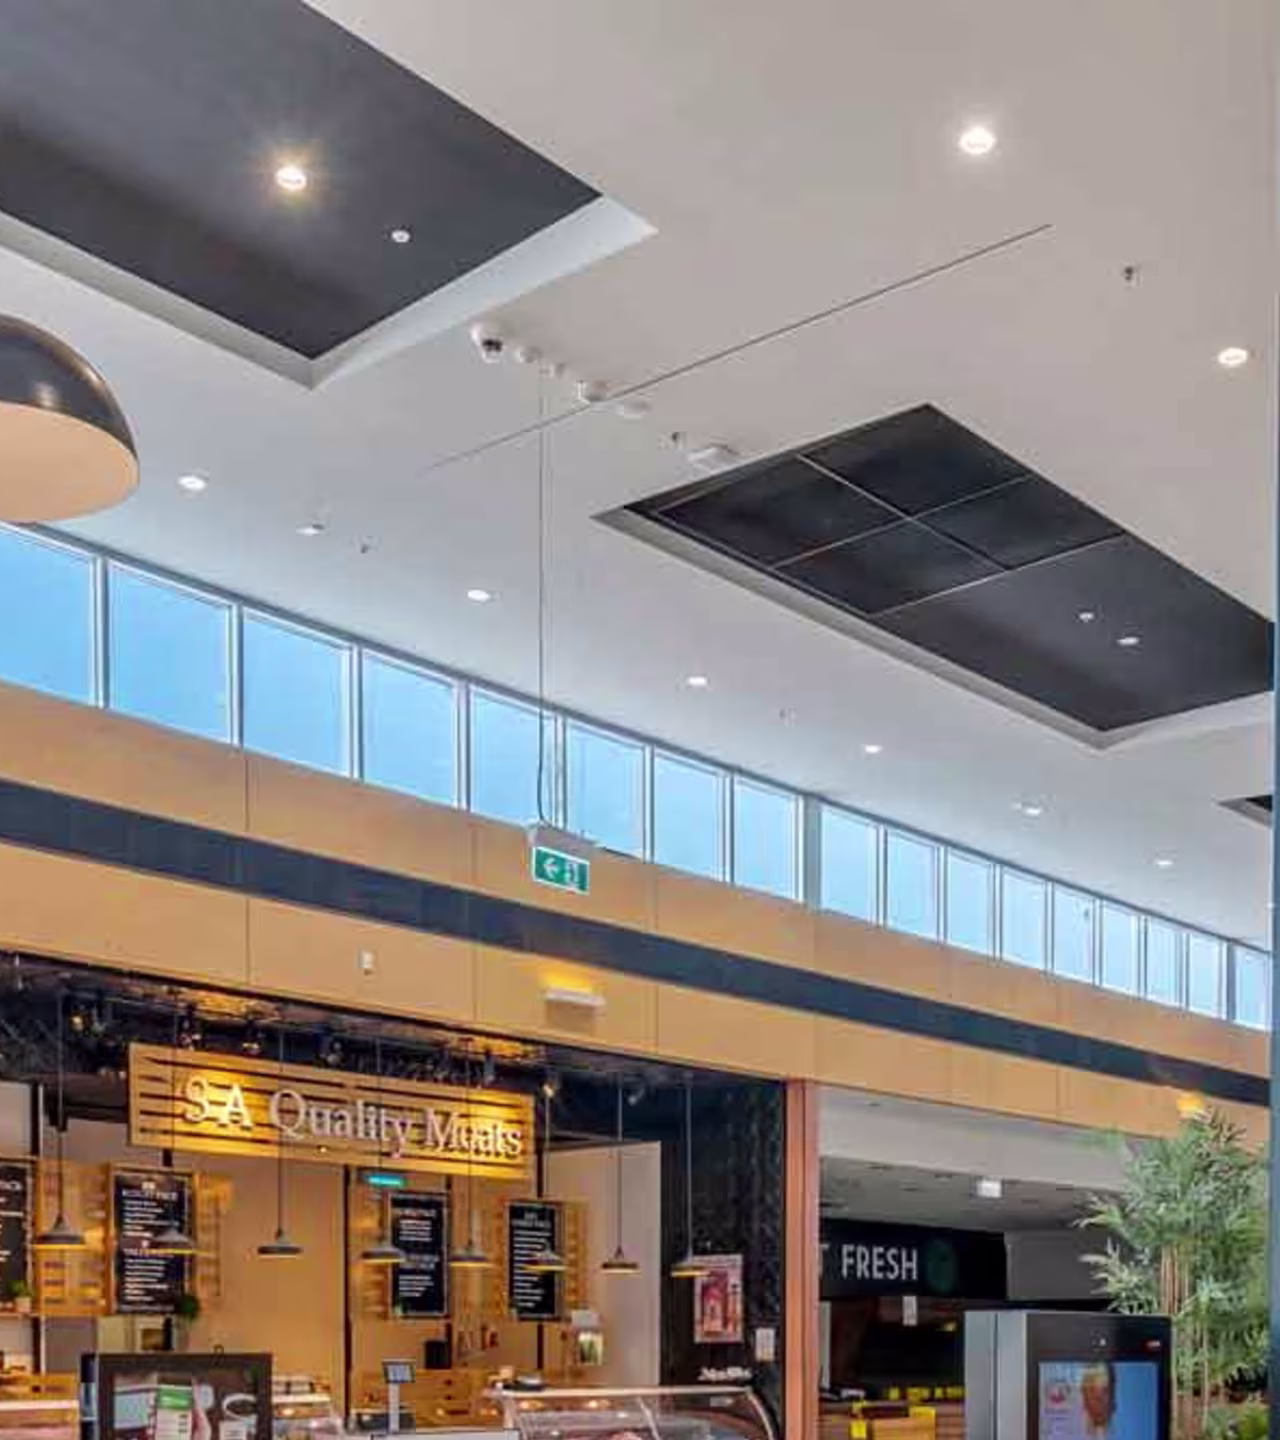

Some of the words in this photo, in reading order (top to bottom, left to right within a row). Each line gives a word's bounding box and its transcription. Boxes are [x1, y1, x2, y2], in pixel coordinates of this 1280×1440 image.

[269, 1089, 413, 1159] Quality
[424, 1108, 523, 1157] Meats
[840, 1244, 919, 1281] FRESH
